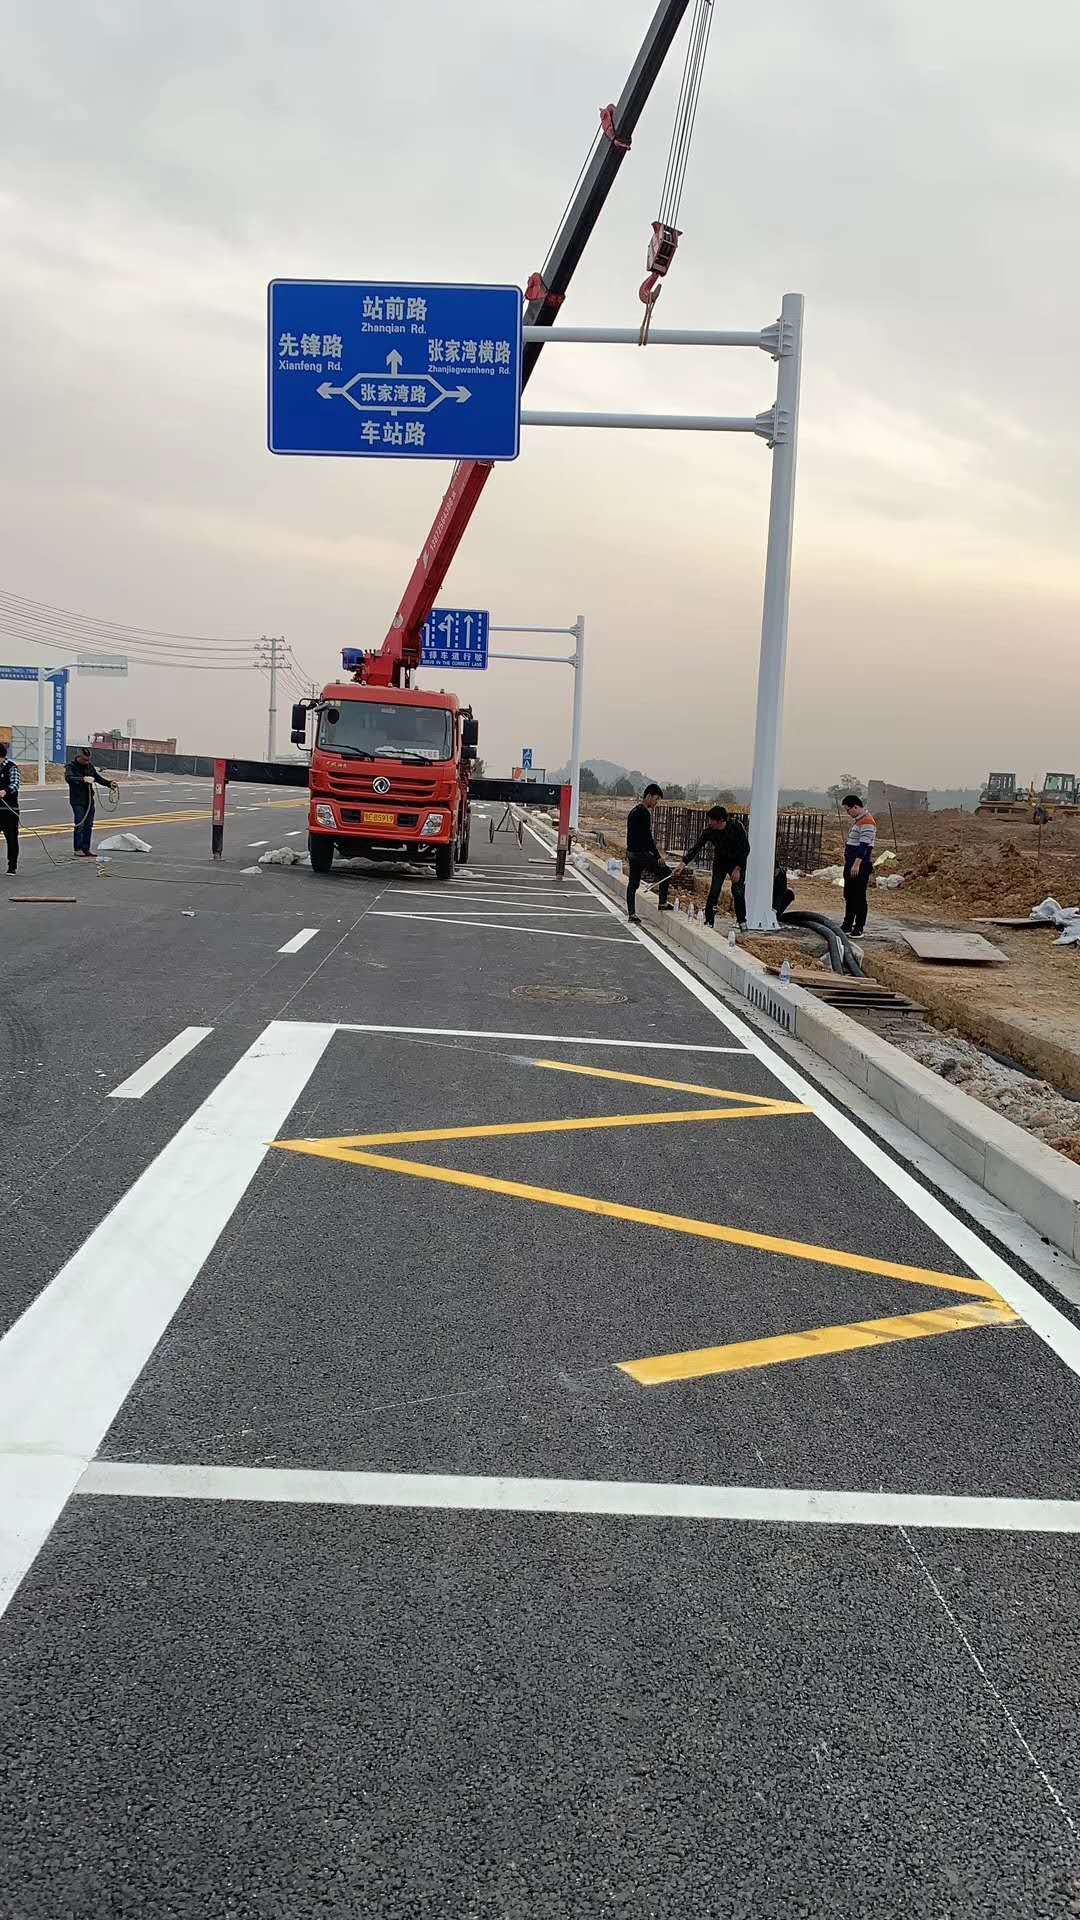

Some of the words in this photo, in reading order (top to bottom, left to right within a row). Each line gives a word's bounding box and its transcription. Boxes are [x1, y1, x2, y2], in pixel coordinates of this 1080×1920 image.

[362, 295, 427, 321] 站前路
[361, 322, 405, 334] Zhanqian
[411, 324, 427, 334] Rd.
[278, 333, 343, 358] 先锋路
[428, 339, 511, 364] 张家湾横路
[278, 360, 322, 373] Xianfeng
[327, 360, 343, 371] Rd.
[498, 366, 511, 375] Rd.
[360, 384, 426, 403] 张家湾路
[361, 420, 426, 446] 车站路
